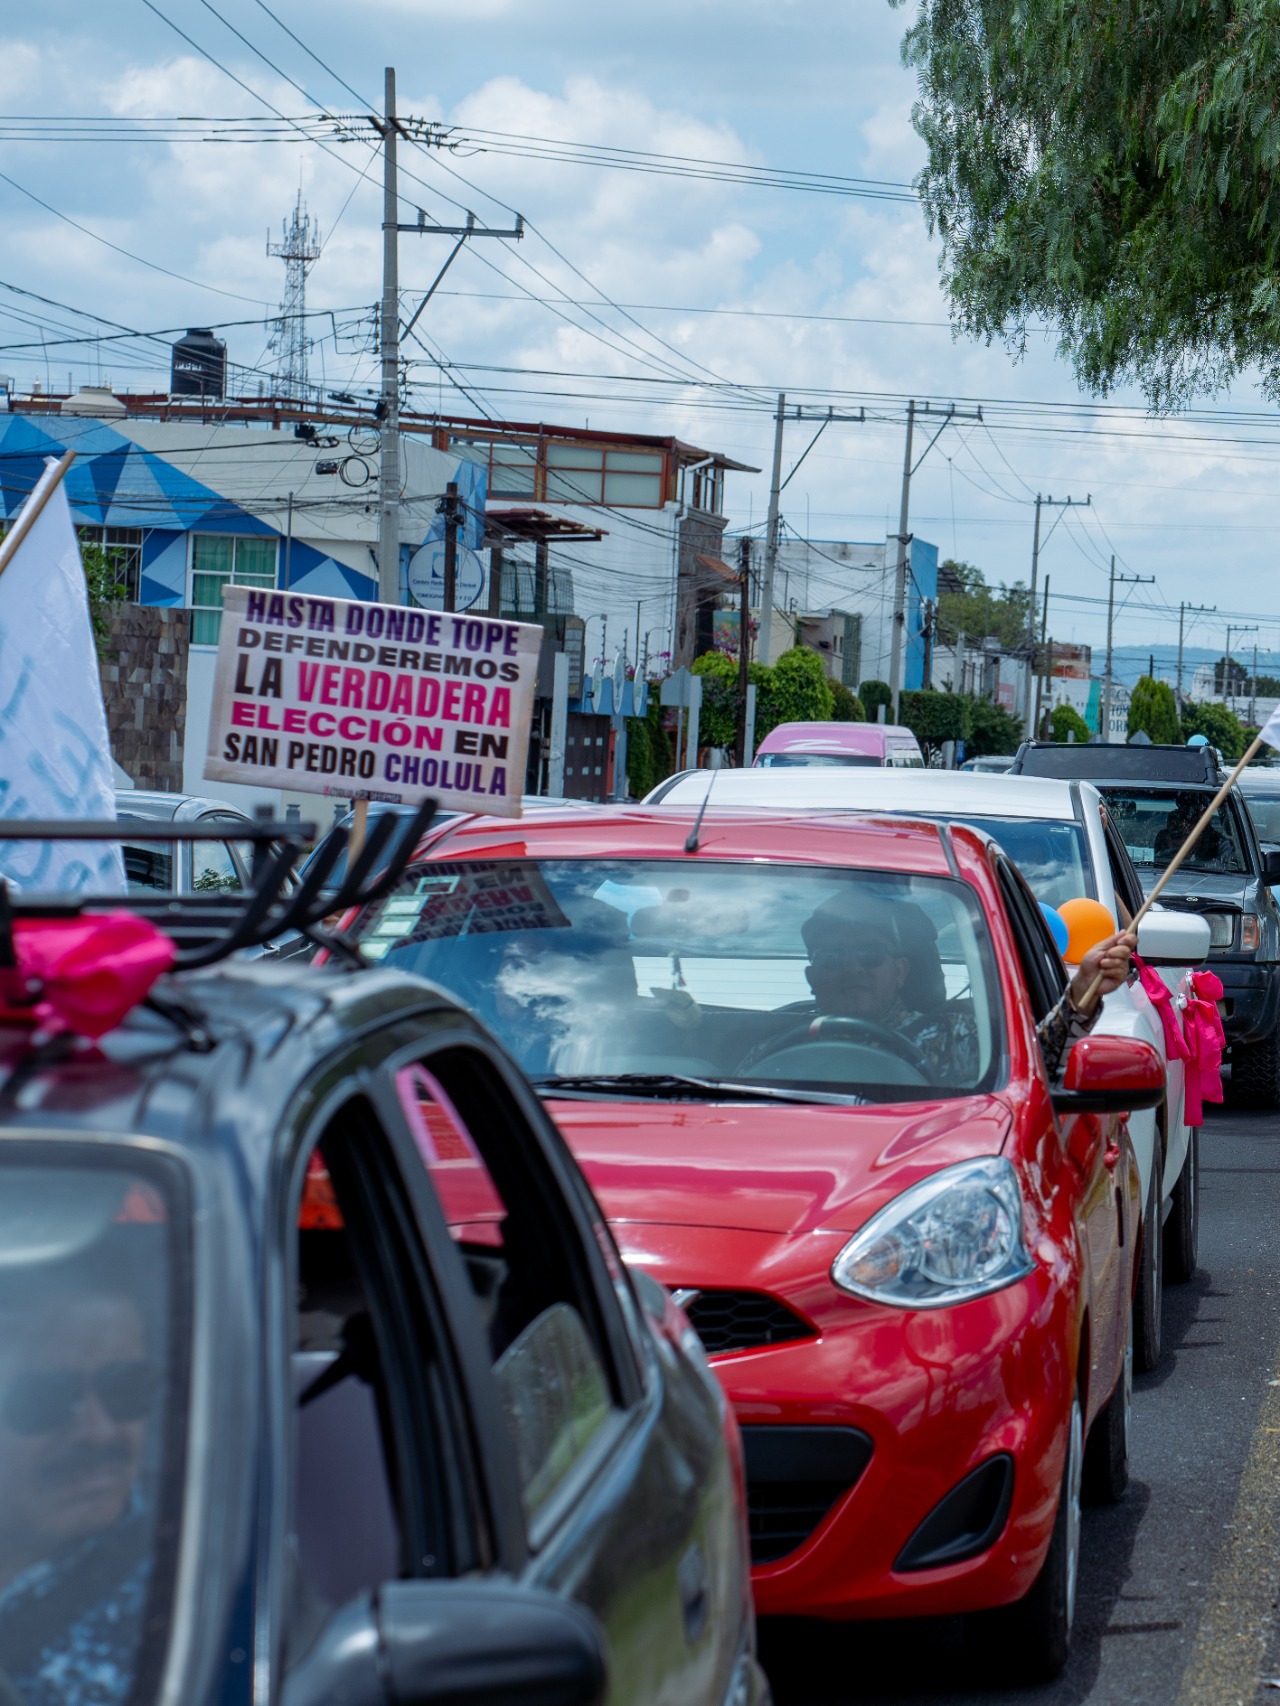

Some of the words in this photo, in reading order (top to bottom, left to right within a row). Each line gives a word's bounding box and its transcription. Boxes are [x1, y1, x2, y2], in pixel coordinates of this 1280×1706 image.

[236, 627, 520, 683] DEFENDEREMOS
[245, 590, 336, 634] HASTA
[345, 604, 442, 647] DONDE
[451, 618, 520, 656] TOPE
[234, 653, 282, 699] LA
[297, 661, 511, 728] VERDADERA
[230, 700, 444, 751] ELECCIÓN
[453, 729, 509, 760] EN
[223, 732, 279, 768] SAN
[287, 740, 375, 779] PEDRO
[383, 753, 507, 797] CHOLULA
